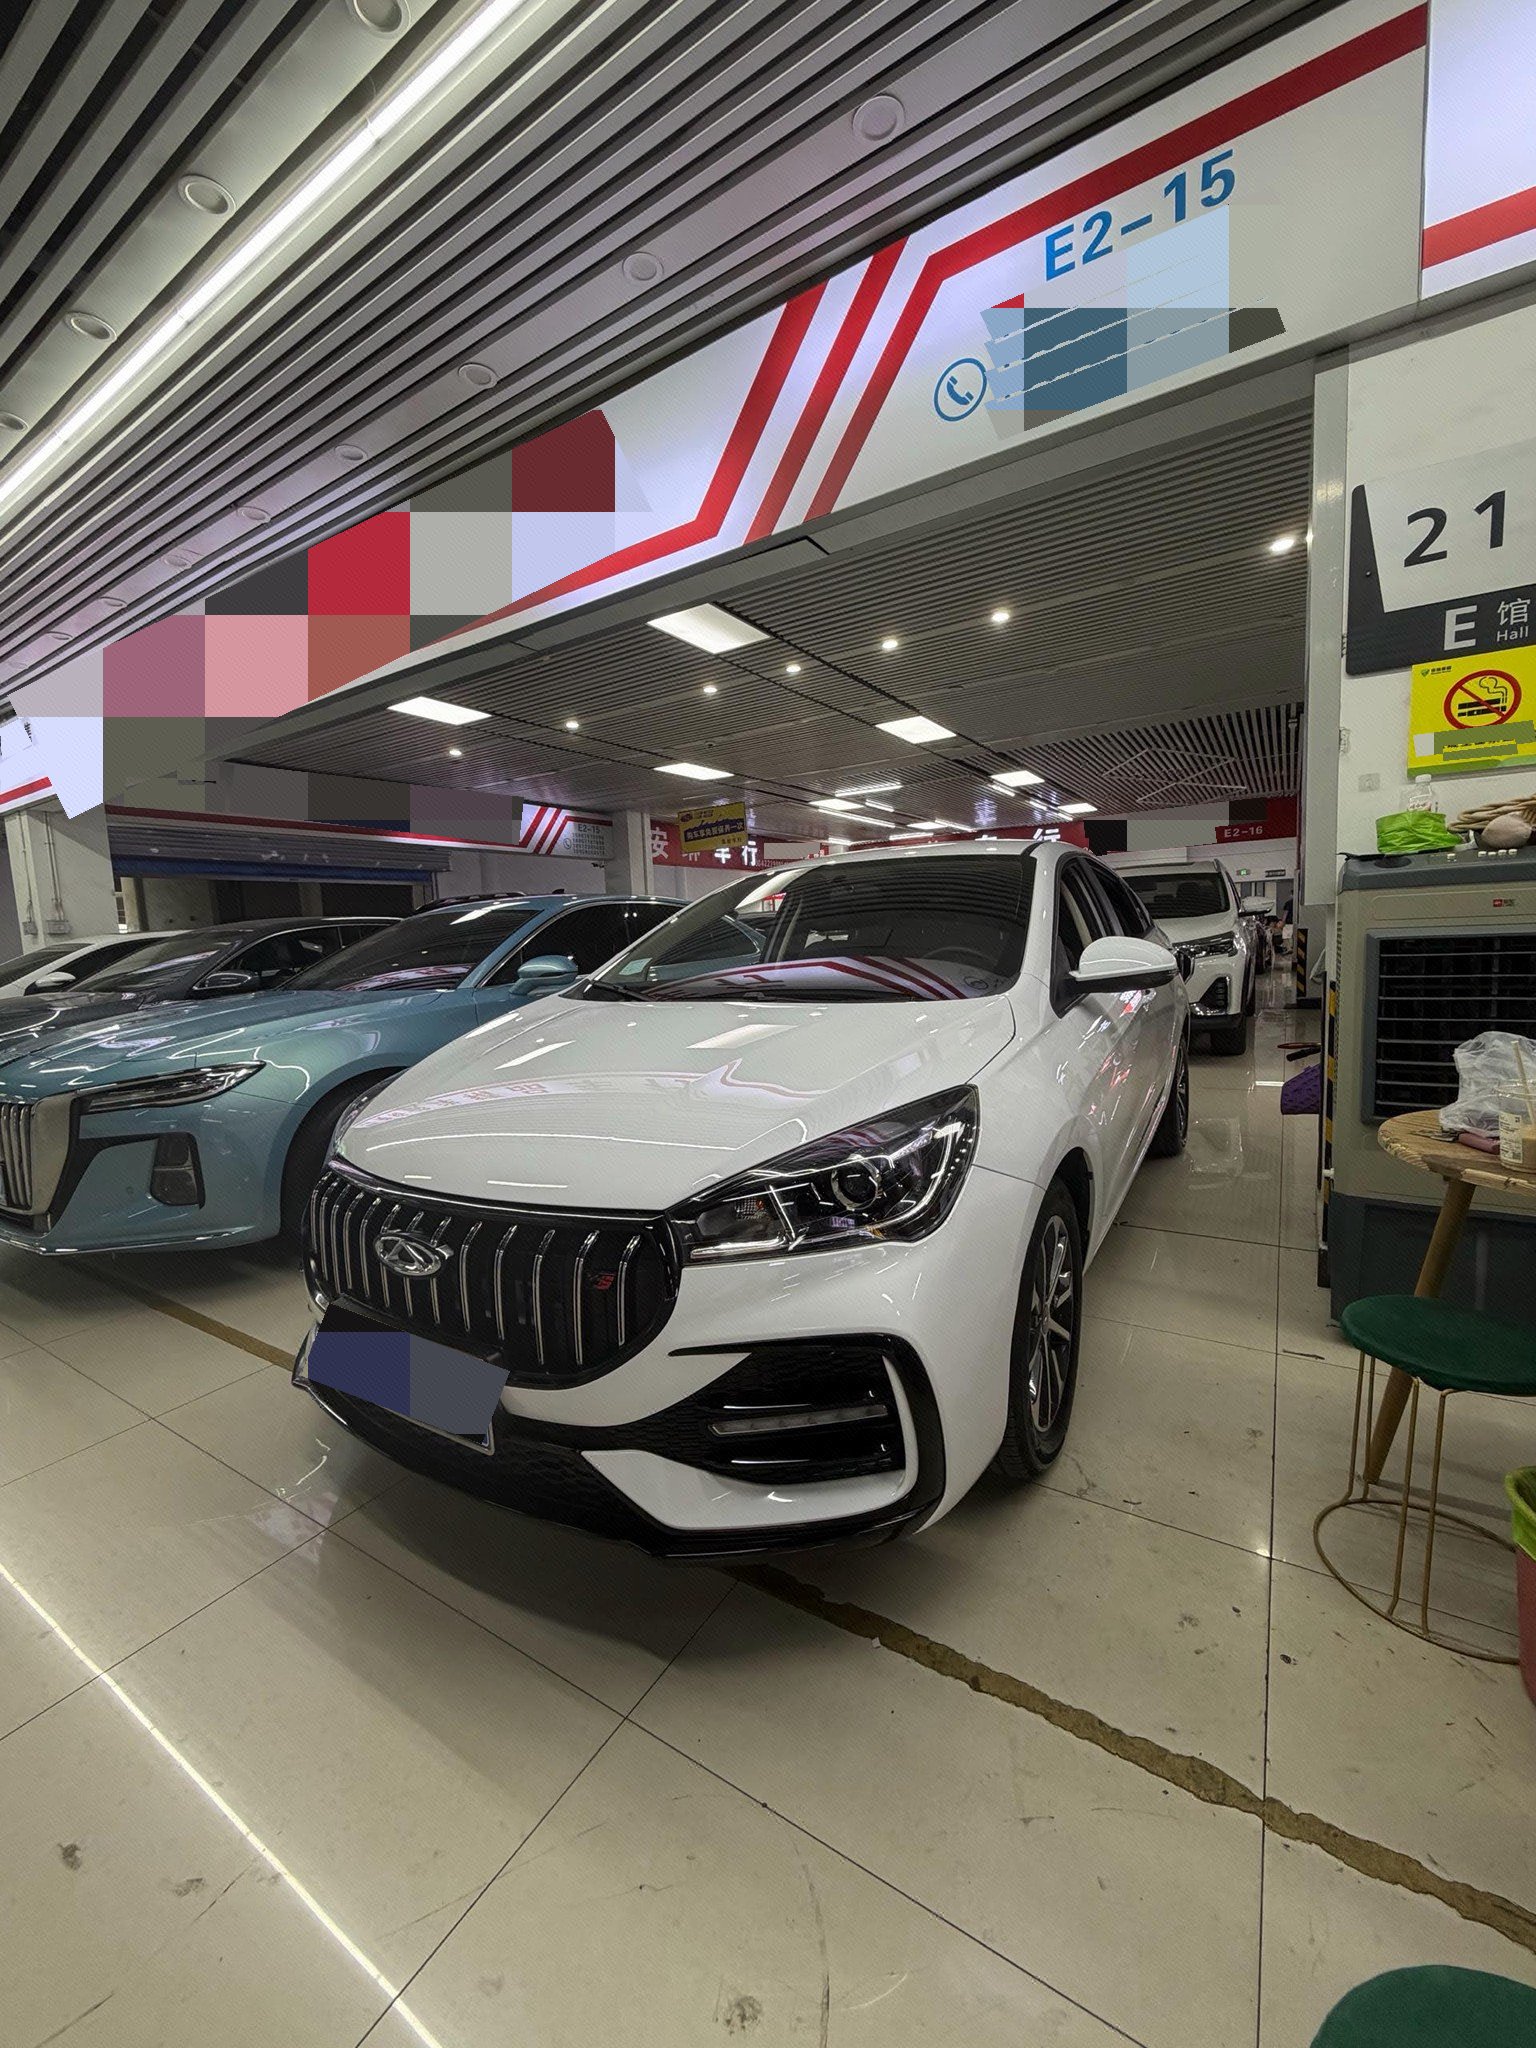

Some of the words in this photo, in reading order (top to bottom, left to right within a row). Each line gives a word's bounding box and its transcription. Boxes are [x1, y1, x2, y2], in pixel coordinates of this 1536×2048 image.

[1045, 148, 1237, 282] E2-15
[1403, 489, 1506, 568] 21
[1443, 604, 1478, 651] E
[1496, 597, 1531, 626] 馆
[1496, 625, 1530, 644] Hall
[1224, 825, 1264, 838] E2-16
